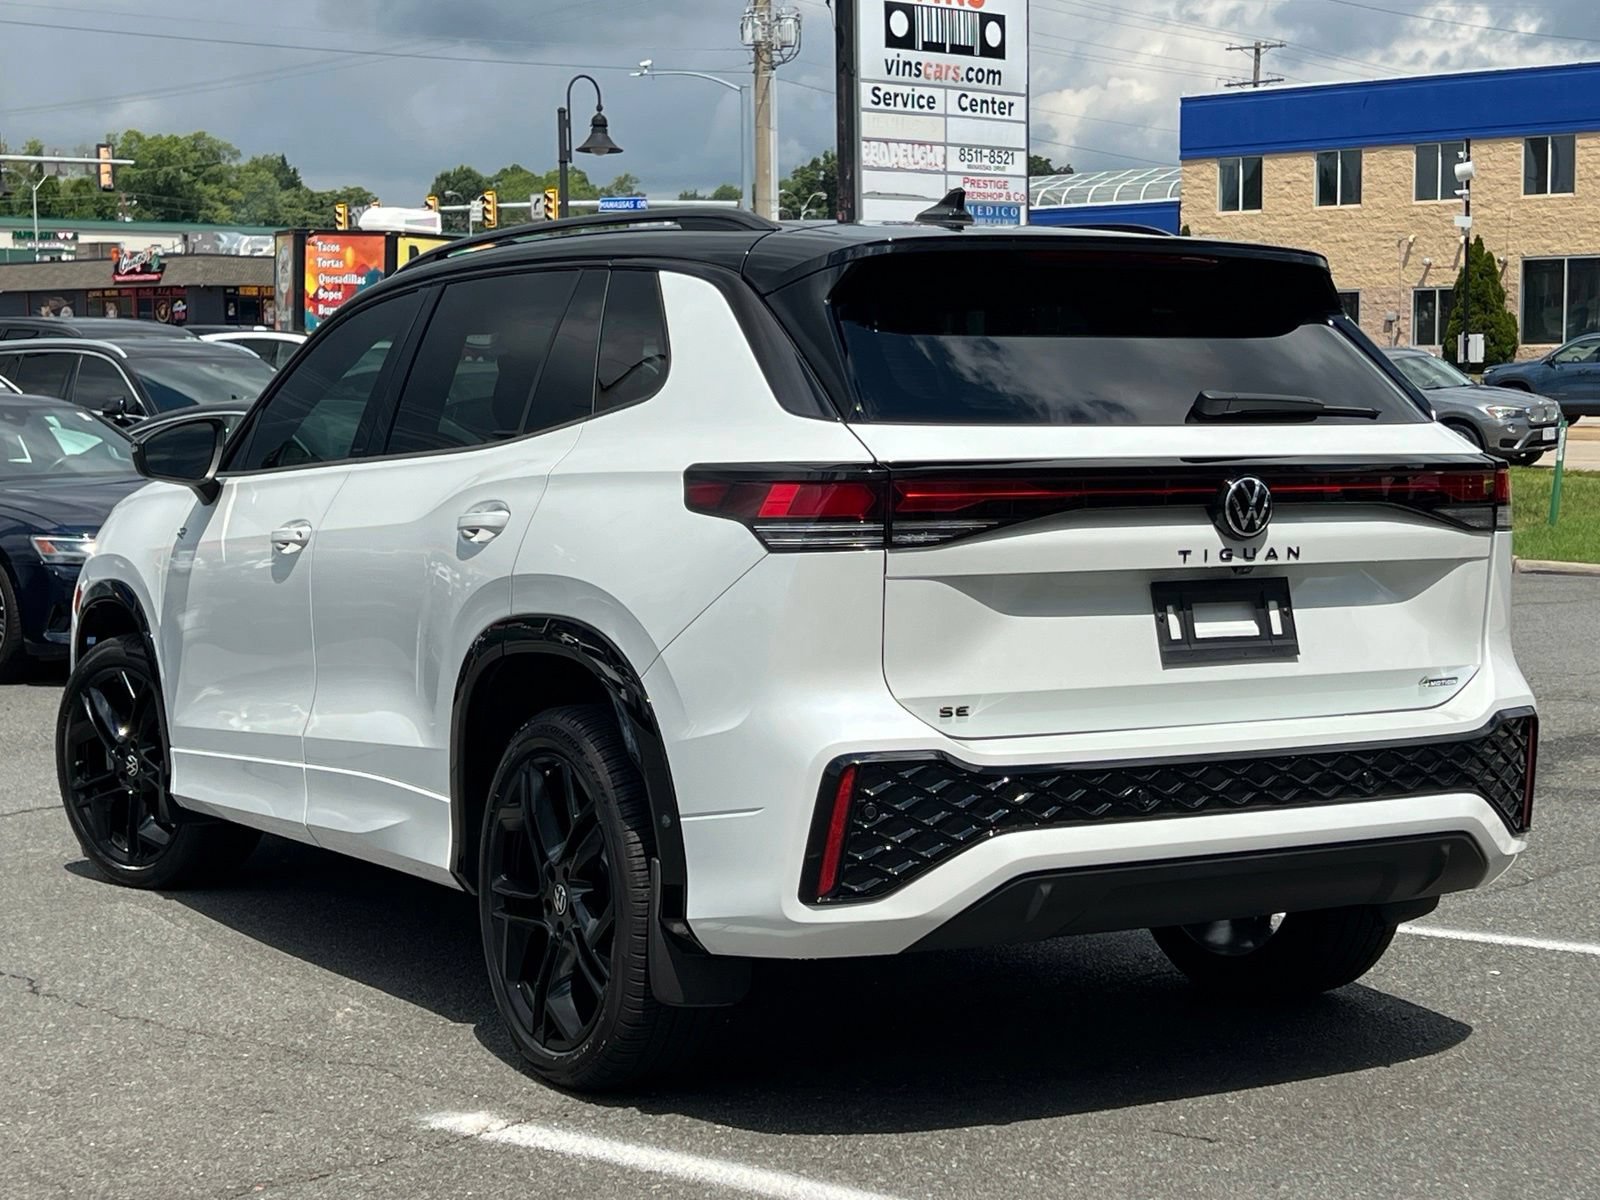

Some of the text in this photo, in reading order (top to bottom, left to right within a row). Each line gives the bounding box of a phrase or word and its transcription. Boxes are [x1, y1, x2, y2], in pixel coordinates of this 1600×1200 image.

[884, 53, 1002, 86] vinscars.com
[871, 87, 1015, 117] Service Center
[959, 148, 1015, 165] 8511-8521
[963, 177, 1009, 190] PRESTIGE
[965, 191, 1004, 201] BERSHOP
[317, 241, 340, 252] Tacos
[317, 257, 344, 269] Tortas
[318, 273, 367, 286] Quesadillas
[317, 288, 343, 301] Sopes
[1178, 546, 1300, 565] TIGUAN
[939, 705, 970, 718] SE
